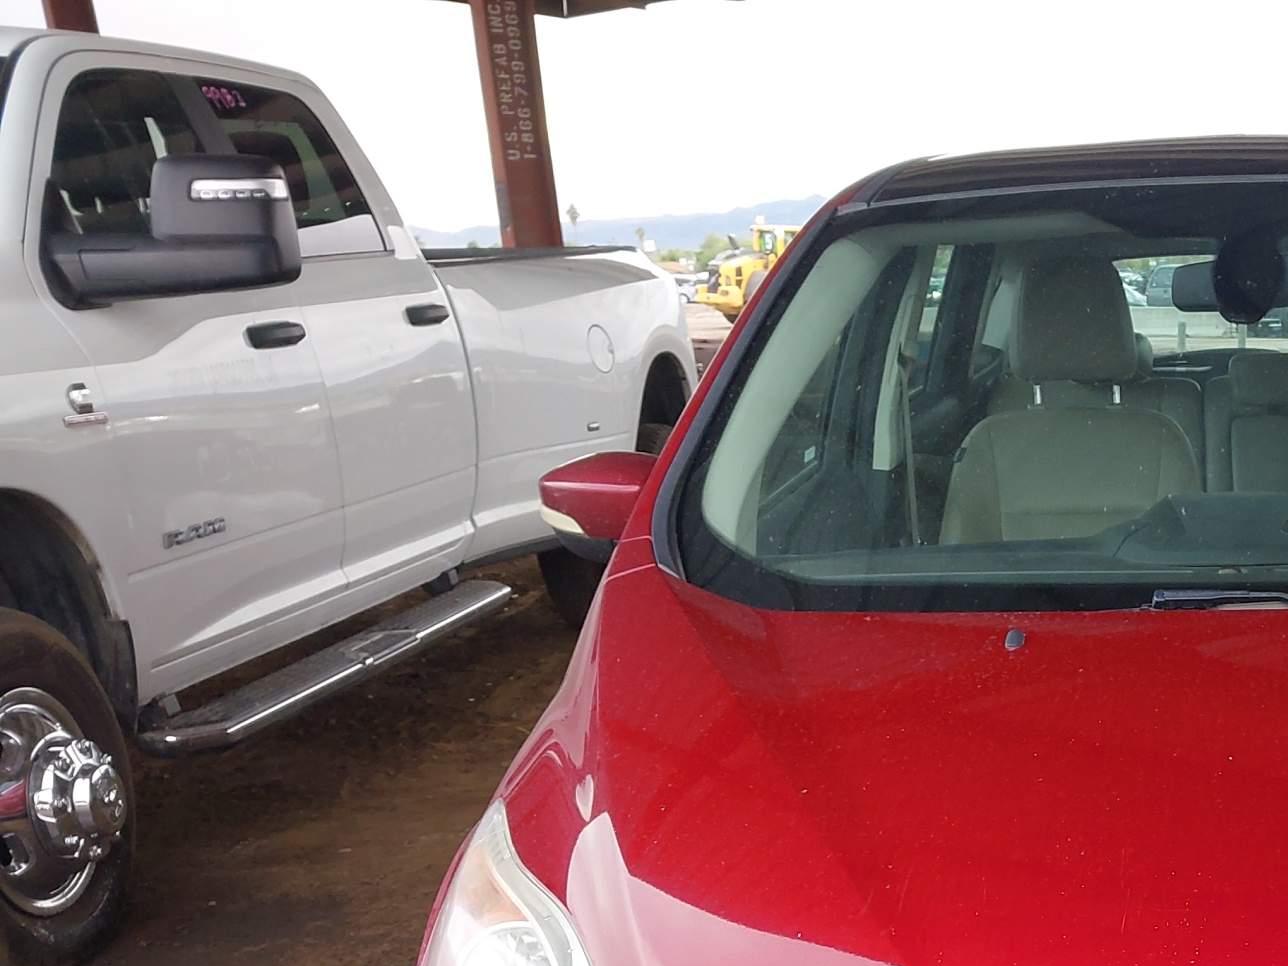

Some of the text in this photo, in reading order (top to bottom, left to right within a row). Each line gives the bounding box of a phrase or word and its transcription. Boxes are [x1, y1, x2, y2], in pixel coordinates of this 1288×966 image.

[492, 43, 515, 115] PREFAB
[503, 0, 537, 159] 1-866-799-0969
[504, 125, 521, 160] U.S.
[162, 517, 226, 550] RAM
